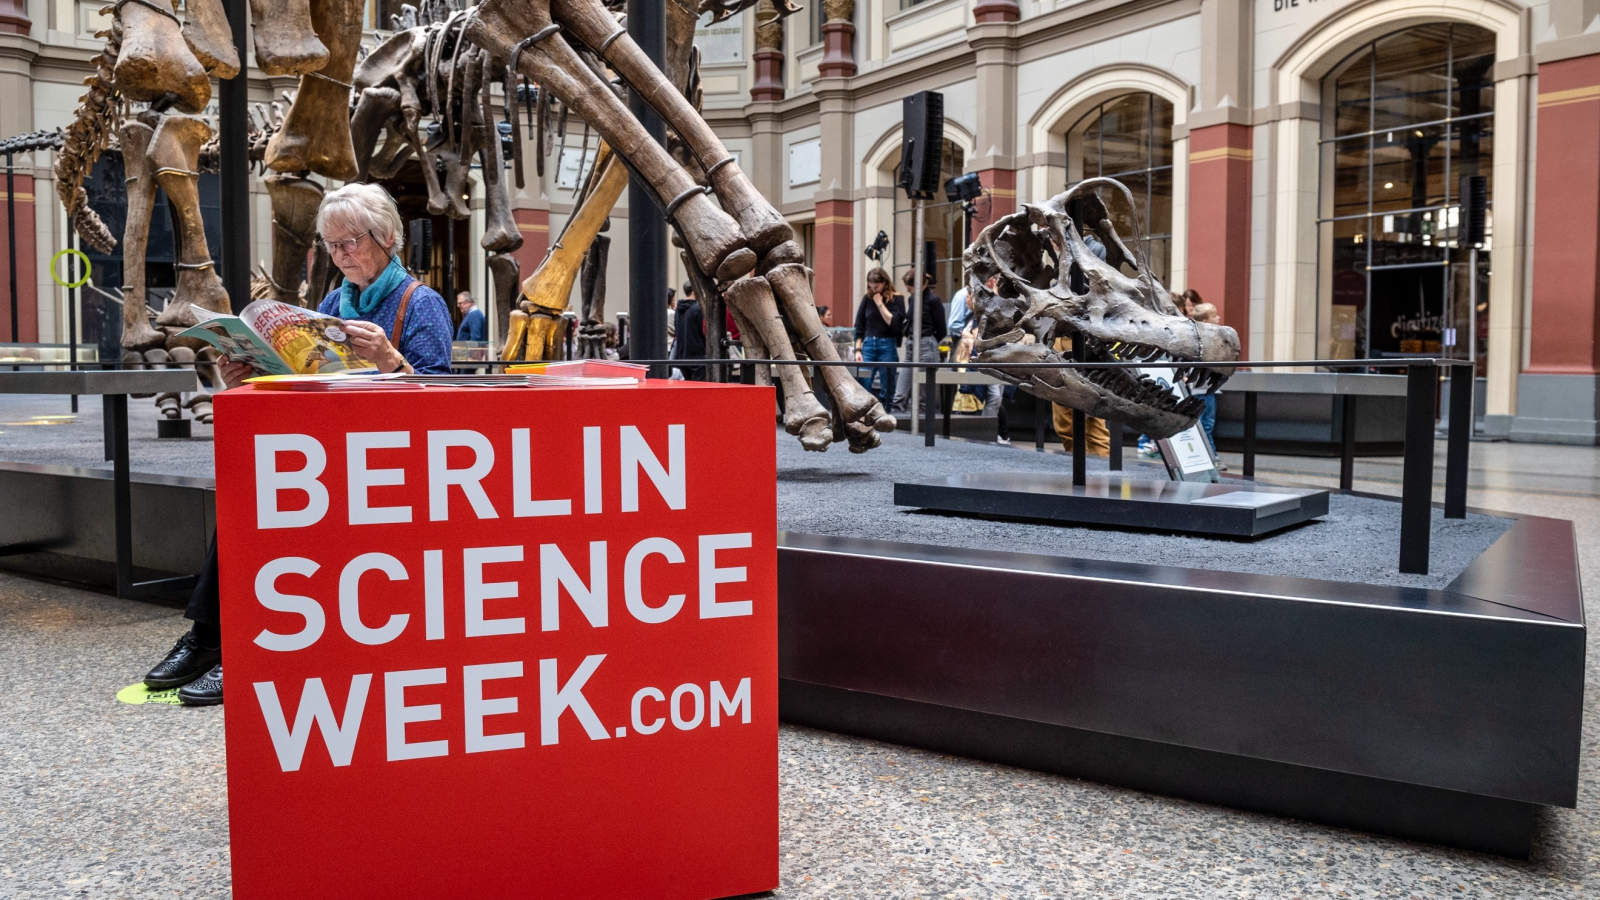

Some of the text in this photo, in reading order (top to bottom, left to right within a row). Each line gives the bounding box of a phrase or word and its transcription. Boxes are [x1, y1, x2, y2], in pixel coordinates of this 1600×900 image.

[254, 303, 292, 333] BERLIN
[263, 312, 311, 344] SCIENCE
[273, 328, 301, 353] WEEK
[254, 423, 687, 529] BERLIN
[252, 532, 753, 651] SCIENCE
